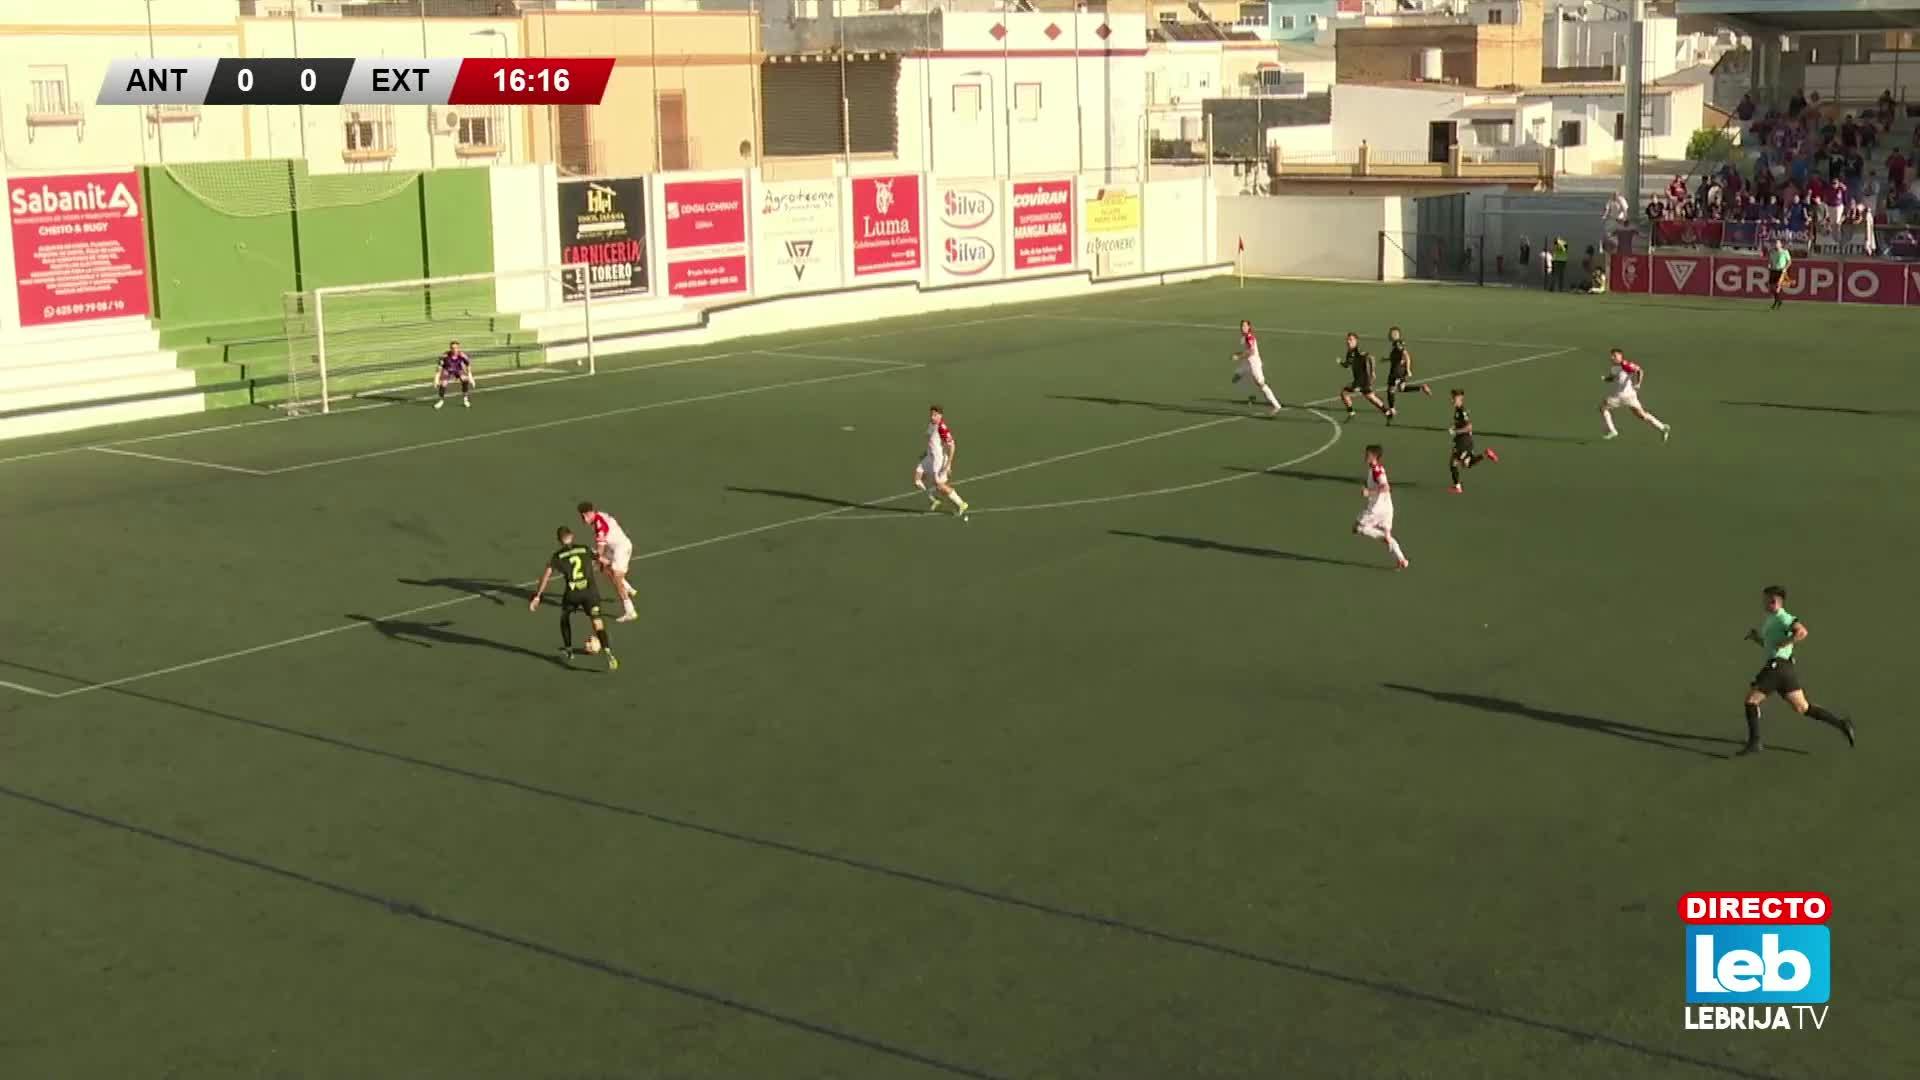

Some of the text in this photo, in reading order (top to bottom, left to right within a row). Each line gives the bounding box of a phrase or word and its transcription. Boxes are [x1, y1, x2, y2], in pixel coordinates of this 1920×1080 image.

[944, 189, 986, 216] Silva
[83, 222, 109, 234] BUGY
[863, 215, 910, 238] Luma
[944, 236, 986, 263] Silva
[591, 262, 632, 282] TORERO
[569, 556, 585, 580] 2
